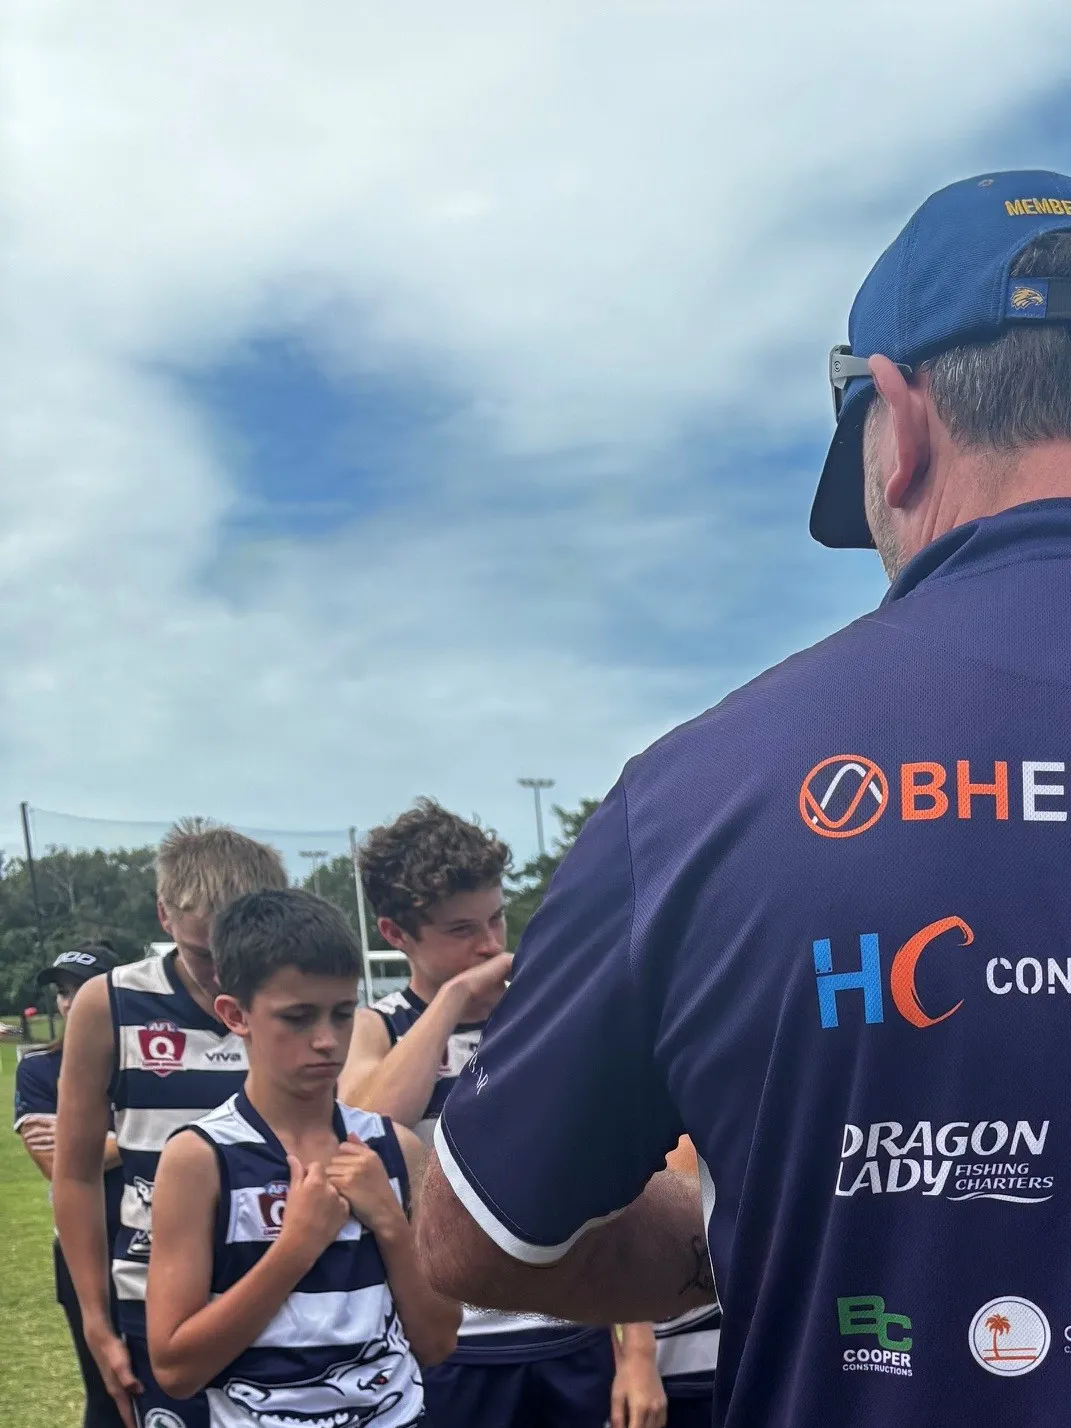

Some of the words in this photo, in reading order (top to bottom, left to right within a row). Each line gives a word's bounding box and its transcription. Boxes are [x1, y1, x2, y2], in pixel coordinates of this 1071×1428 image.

[813, 916, 974, 1028] HC
[149, 1036, 175, 1060] Q
[841, 1120, 1049, 1158] DRAGON
[835, 1159, 954, 1197] LADY
[955, 1163, 1029, 1176] FISHING
[955, 1177, 1054, 1190] CHARTERS
[837, 1296, 912, 1350] BC
[843, 1349, 912, 1367] COOPER
[843, 1363, 913, 1377] CONSTRUCTIONS
